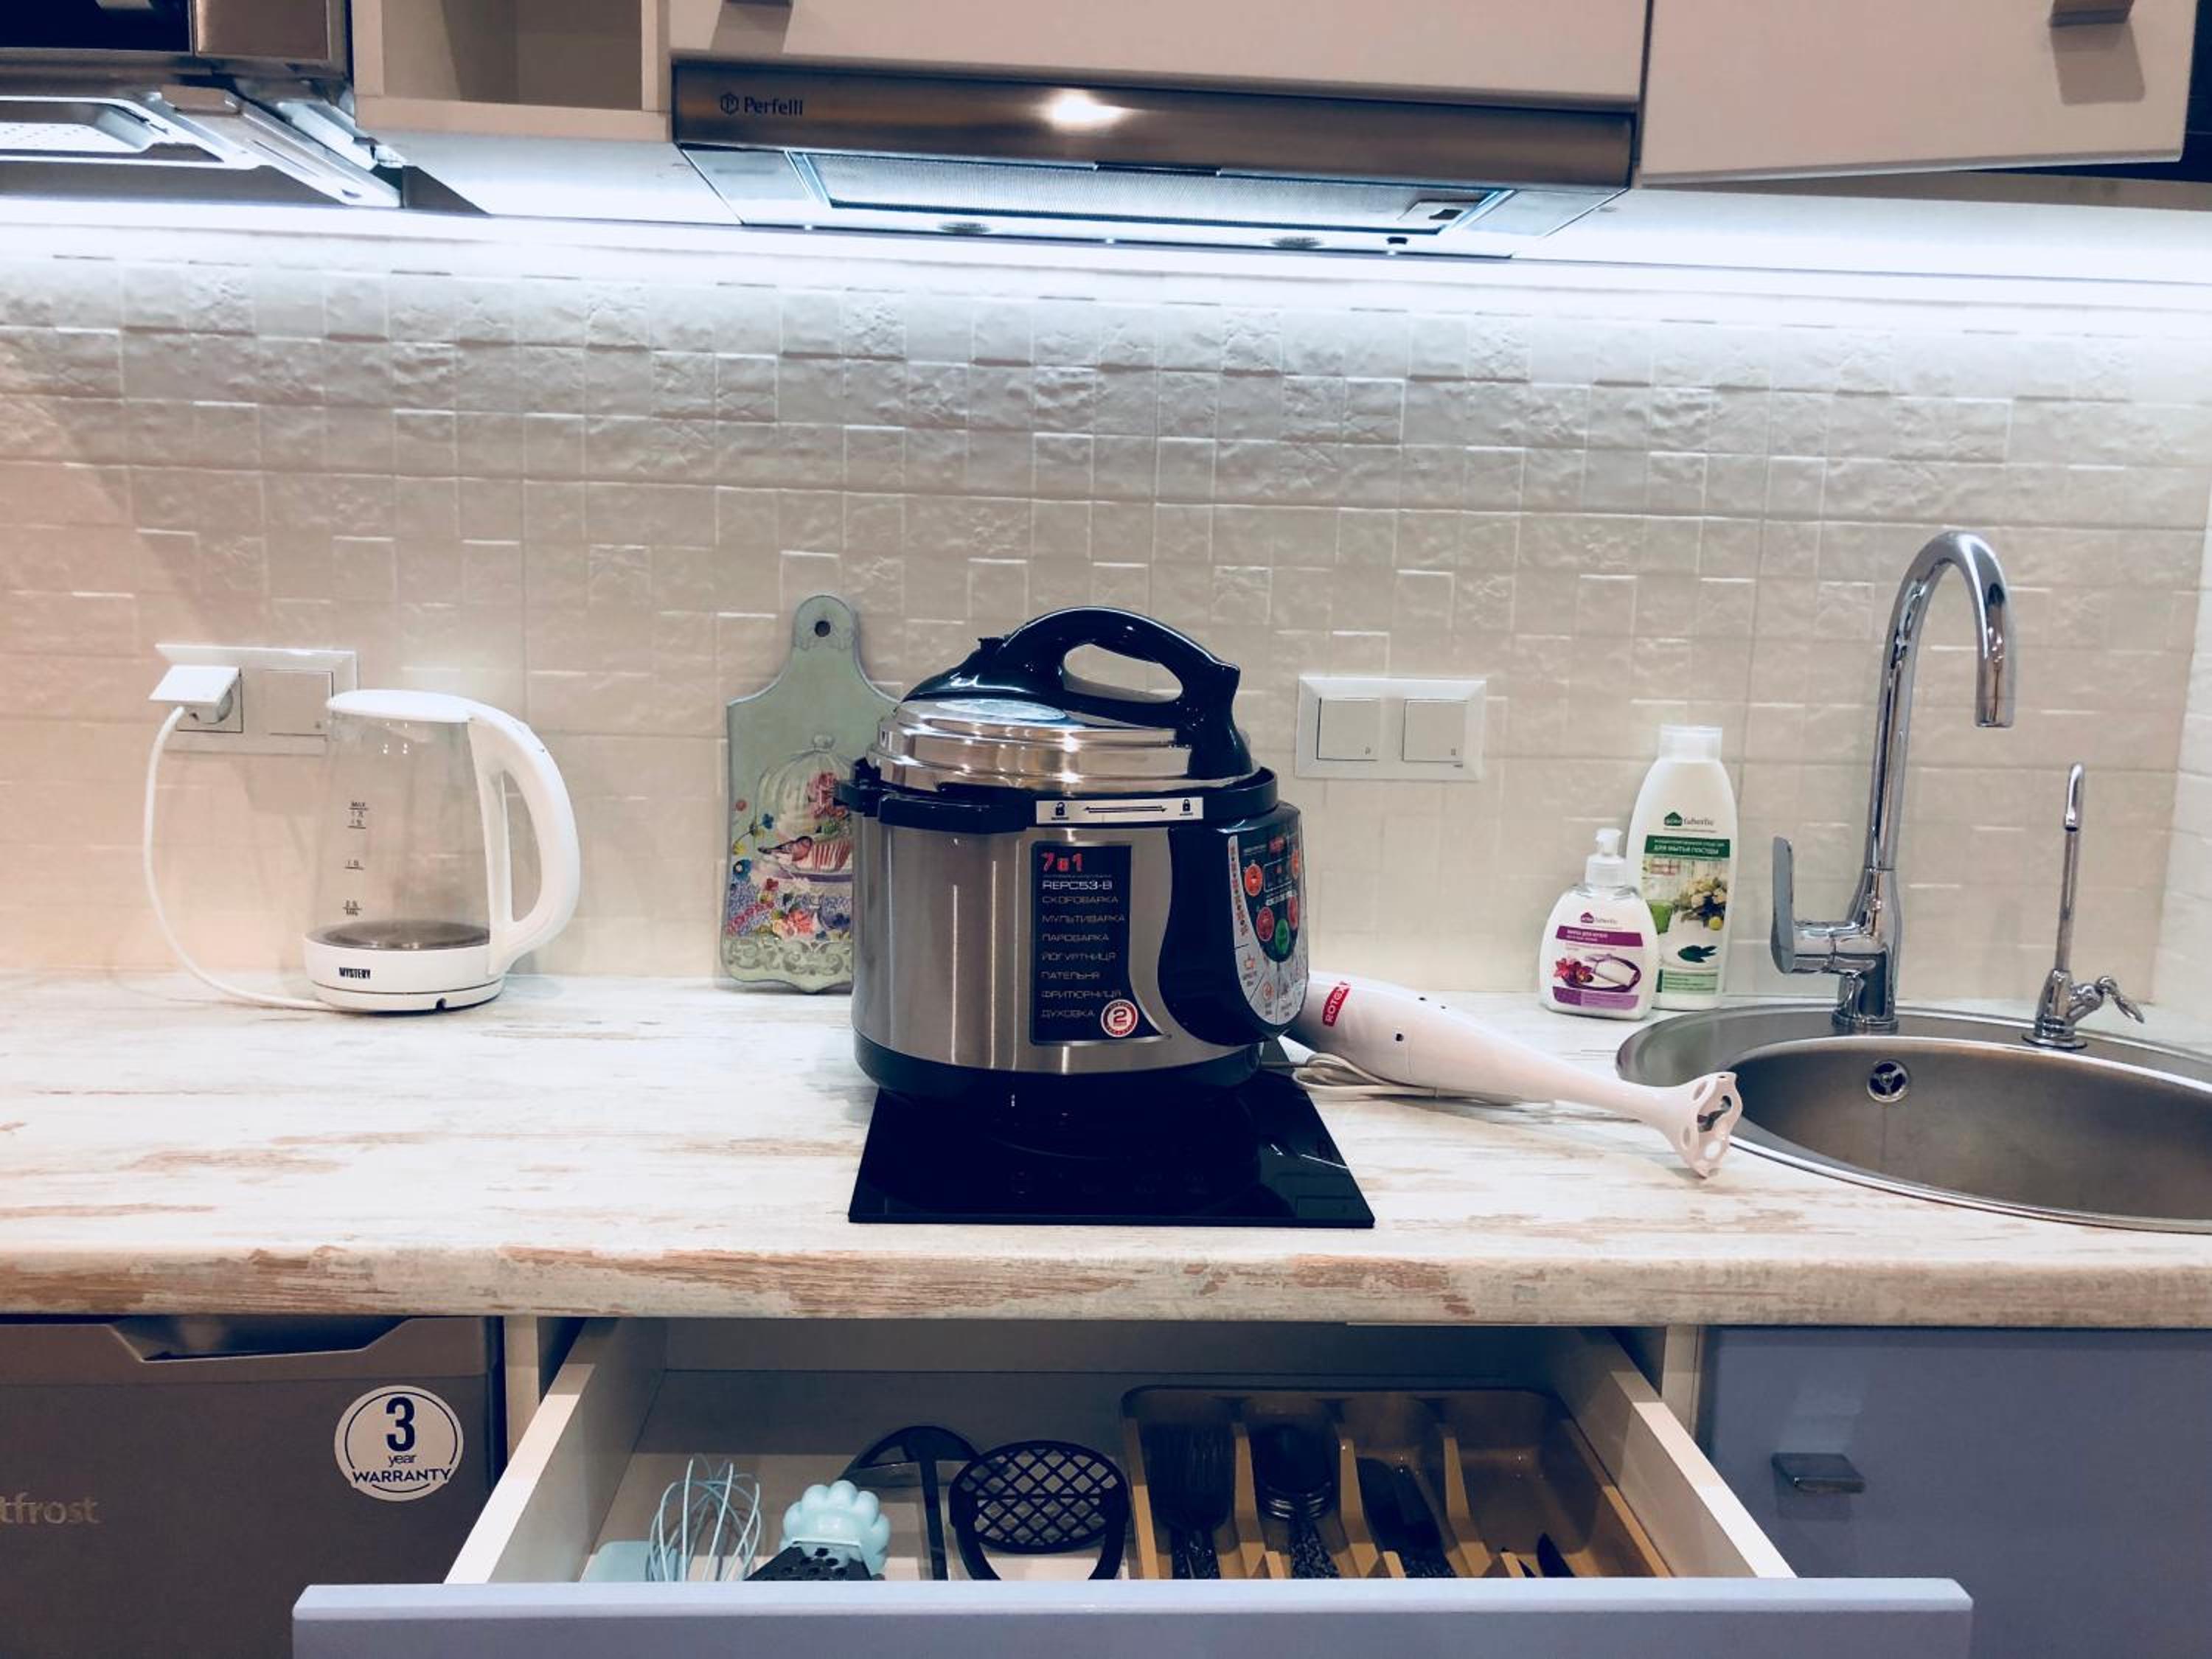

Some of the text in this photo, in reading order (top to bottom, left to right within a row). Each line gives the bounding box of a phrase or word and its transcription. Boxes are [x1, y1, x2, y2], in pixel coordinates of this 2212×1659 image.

[744, 96, 803, 116] Perfelli
[1041, 852, 1054, 872] 7
[1072, 852, 1083, 872] 1
[1042, 896, 1119, 904] СКОРОВАРКА
[1042, 915, 1125, 923] МУЛЬТИВАРКА
[338, 967, 371, 980] MYSTERY
[1113, 1008, 1127, 1023] 2
[386, 1397, 416, 1453] 3
[388, 1455, 417, 1468] year
[352, 1468, 452, 1484] WARRANTY
